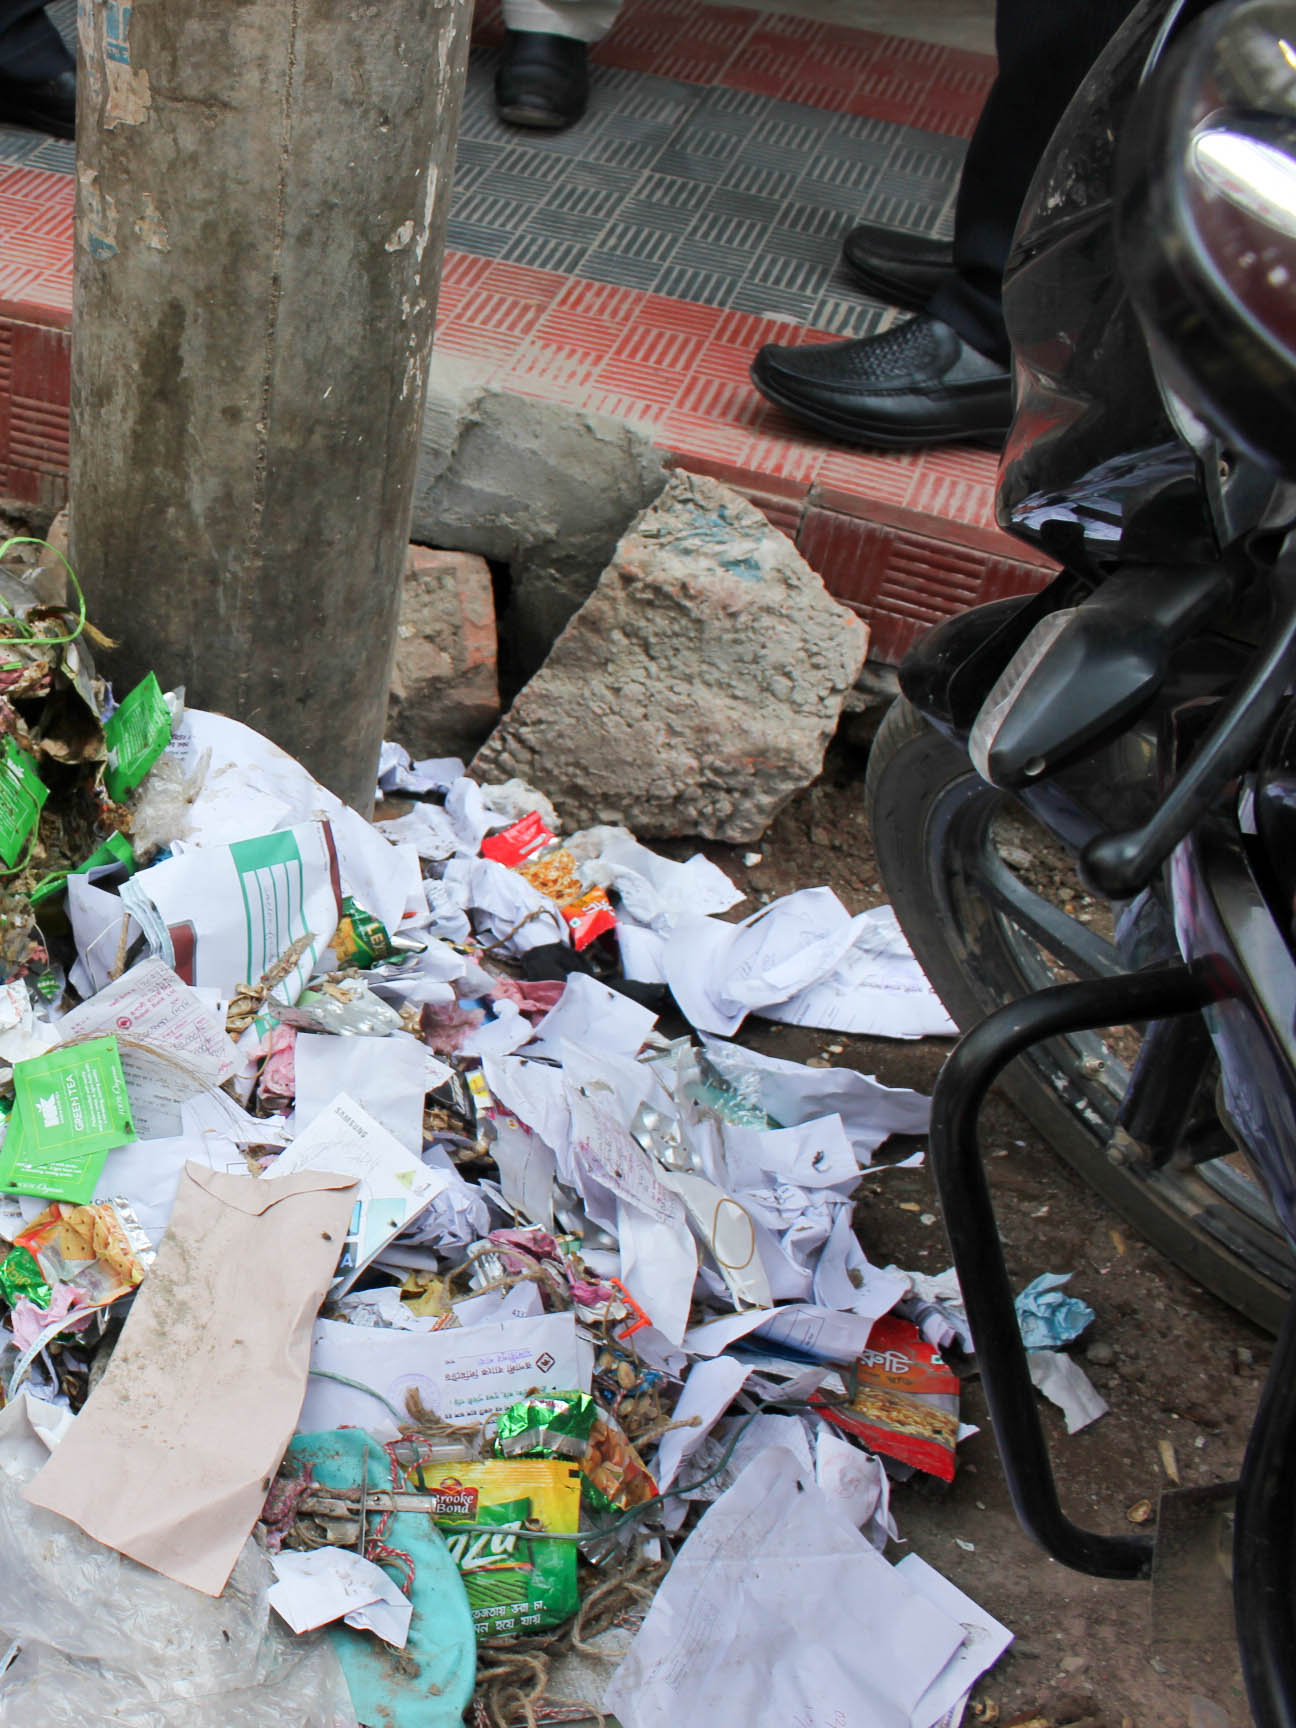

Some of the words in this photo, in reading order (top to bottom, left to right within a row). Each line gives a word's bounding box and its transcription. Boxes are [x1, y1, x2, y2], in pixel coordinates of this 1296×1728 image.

[65, 1074, 77, 1097] TEA
[71, 1100, 85, 1132] GREEN
[334, 1106, 369, 1138] SAMSUNG
[436, 1503, 469, 1514] Bond
